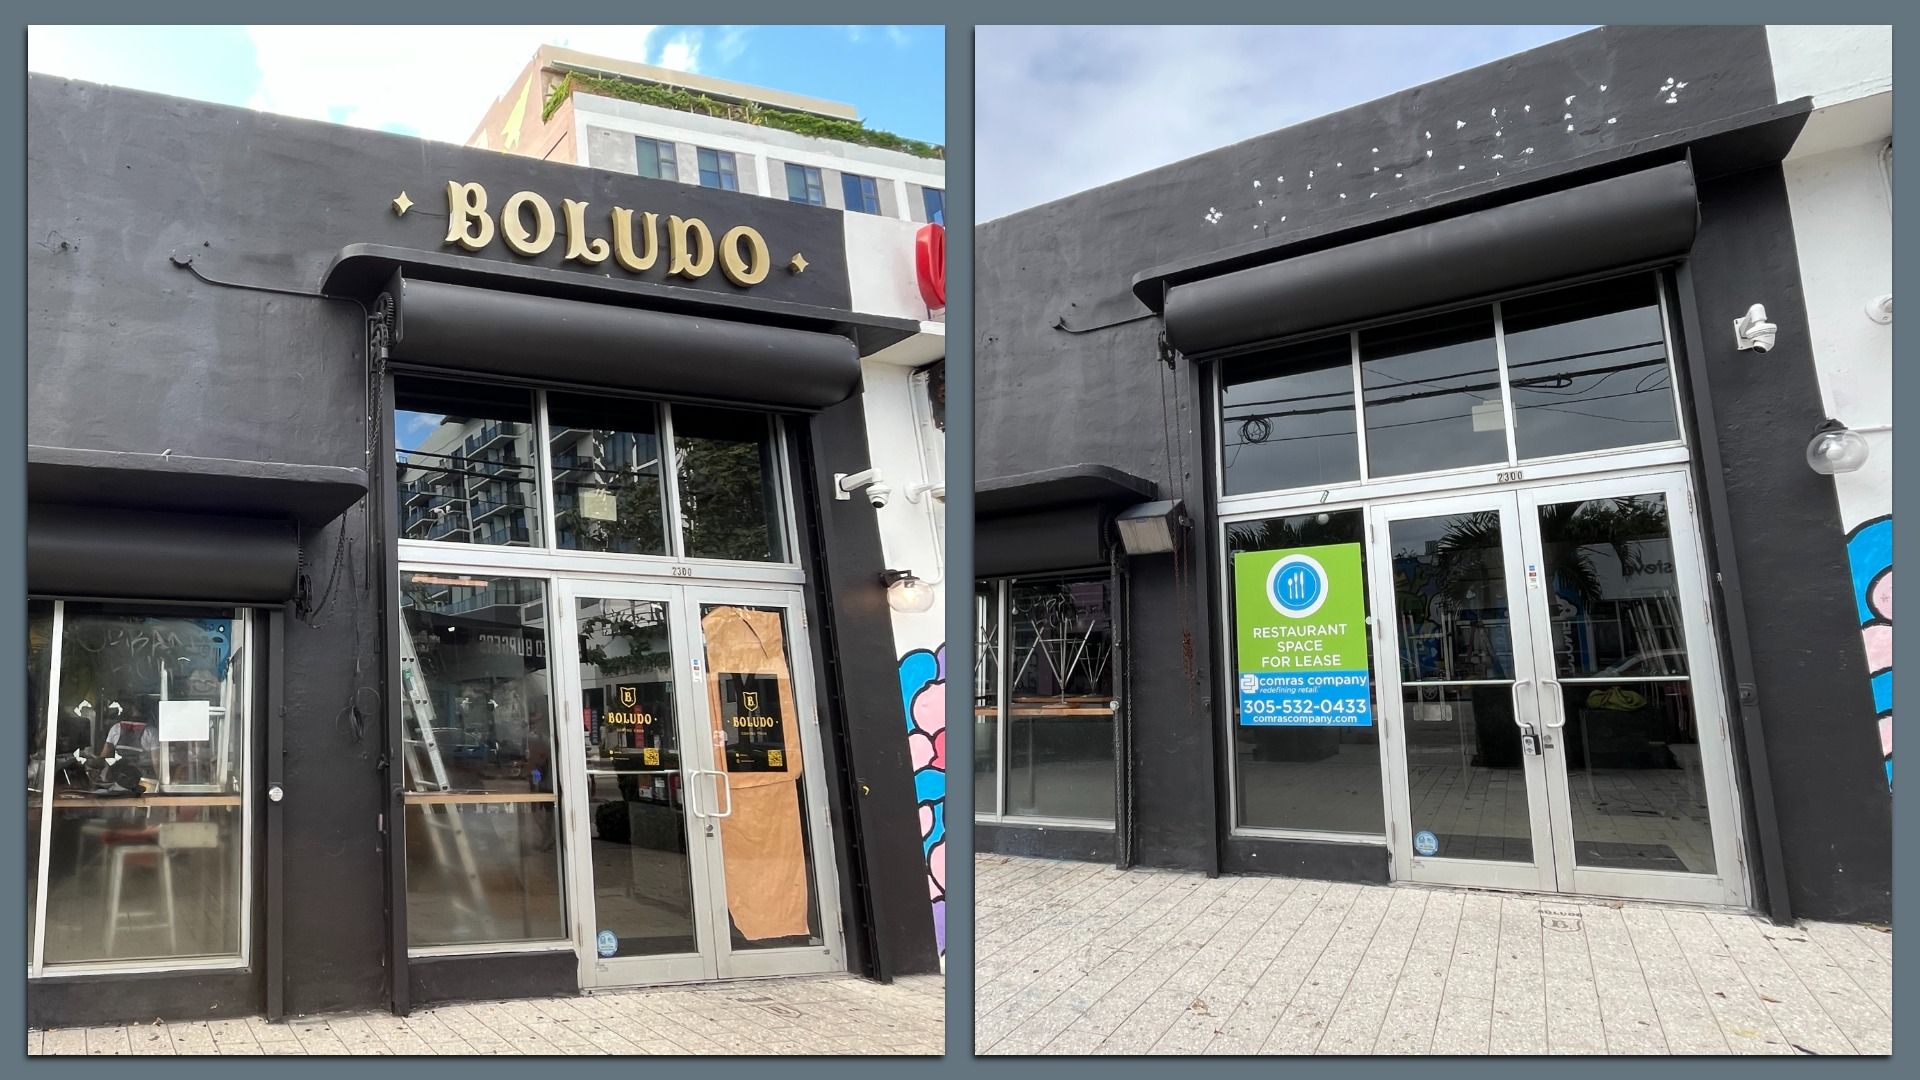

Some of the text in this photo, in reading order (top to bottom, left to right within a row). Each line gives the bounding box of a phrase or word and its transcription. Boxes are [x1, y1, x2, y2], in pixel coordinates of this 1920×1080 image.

[445, 180, 771, 287] BOLUDO
[1497, 471, 1523, 482] 2300
[671, 566, 692, 576] 2300
[1253, 624, 1348, 638] RESTAURANT
[1277, 640, 1323, 652] SPACE
[1261, 655, 1342, 668] FOR LEASE
[1259, 675, 1367, 687] comras company
[1259, 686, 1296, 694] redefining
[1244, 699, 1367, 714] 305-532-0433
[608, 712, 652, 725] BOLUDO
[732, 716, 774, 728] BOLUDO
[1253, 715, 1358, 724] comrascompany.com
